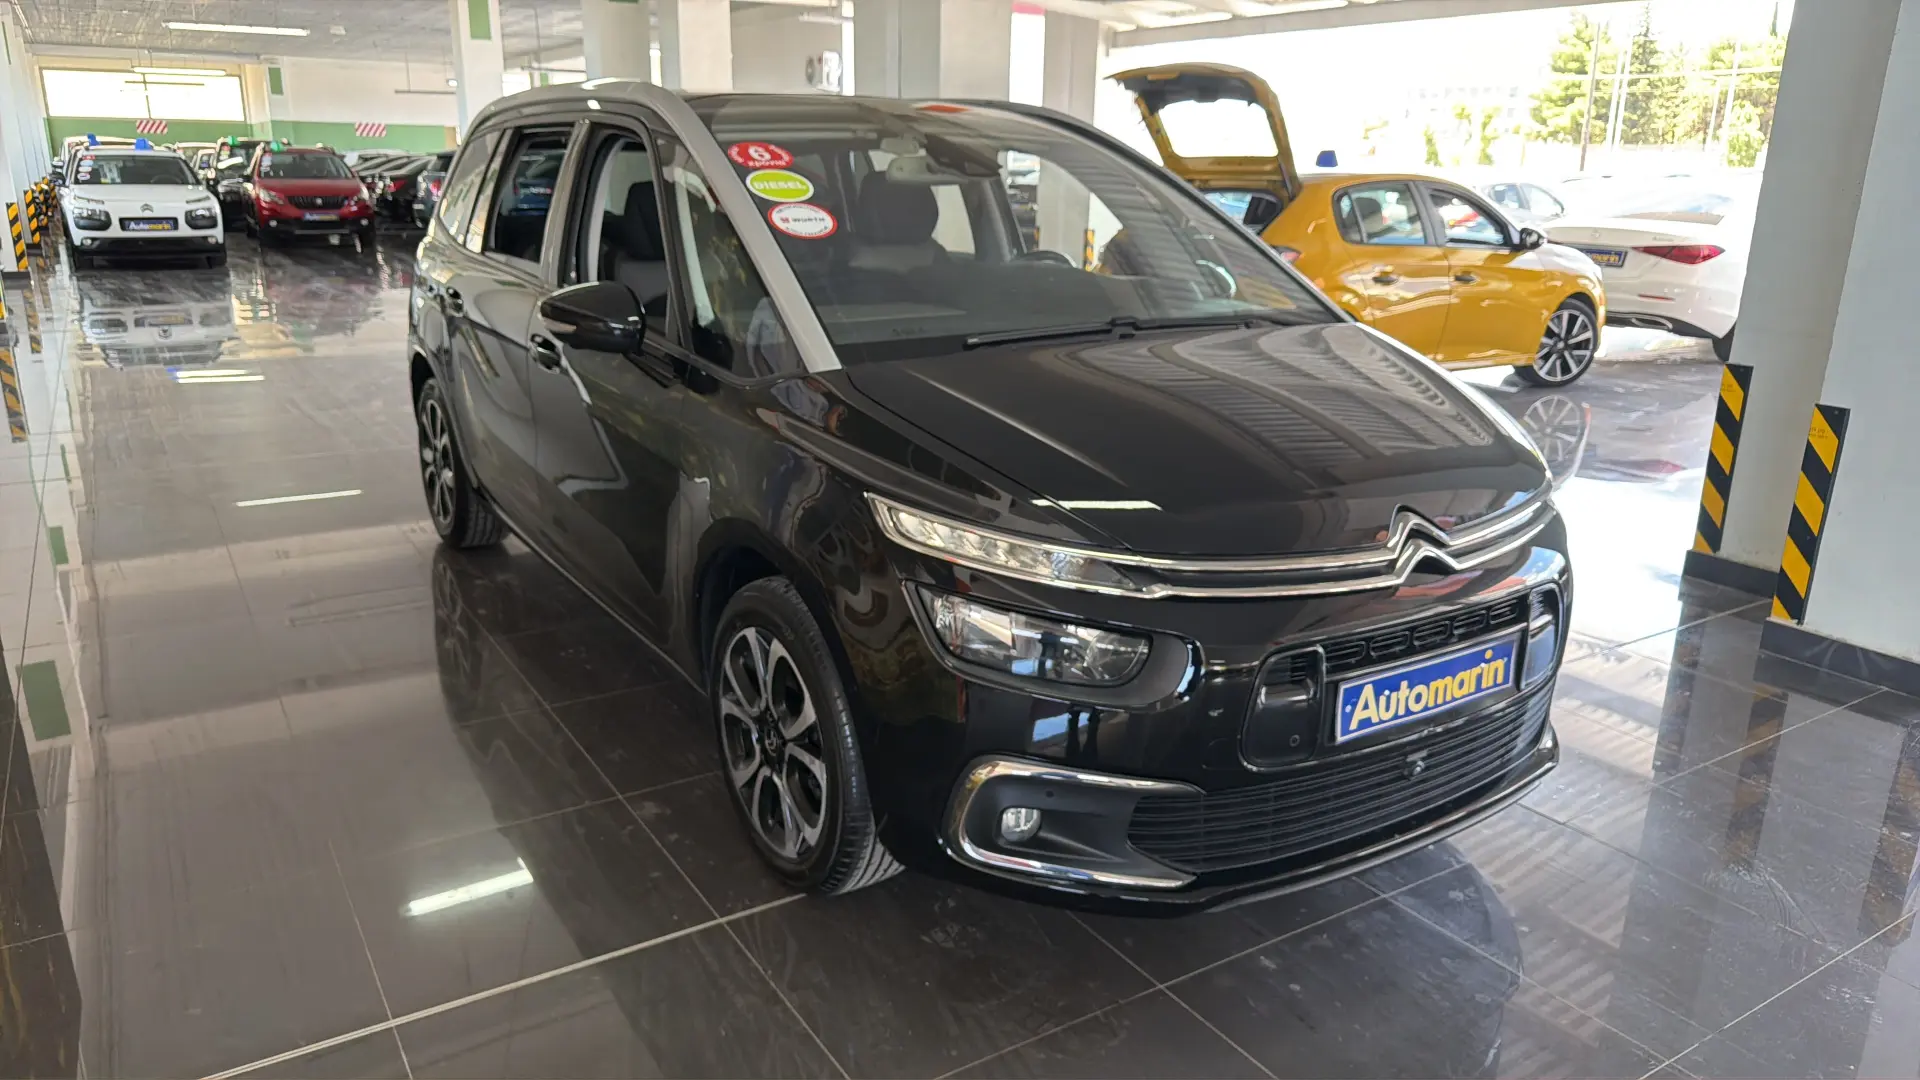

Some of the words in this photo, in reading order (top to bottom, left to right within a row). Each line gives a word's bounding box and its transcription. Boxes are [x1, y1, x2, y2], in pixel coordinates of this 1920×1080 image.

[748, 145, 772, 161] 6
[753, 180, 807, 190] DIESEL
[1348, 649, 1505, 731] Automarin
